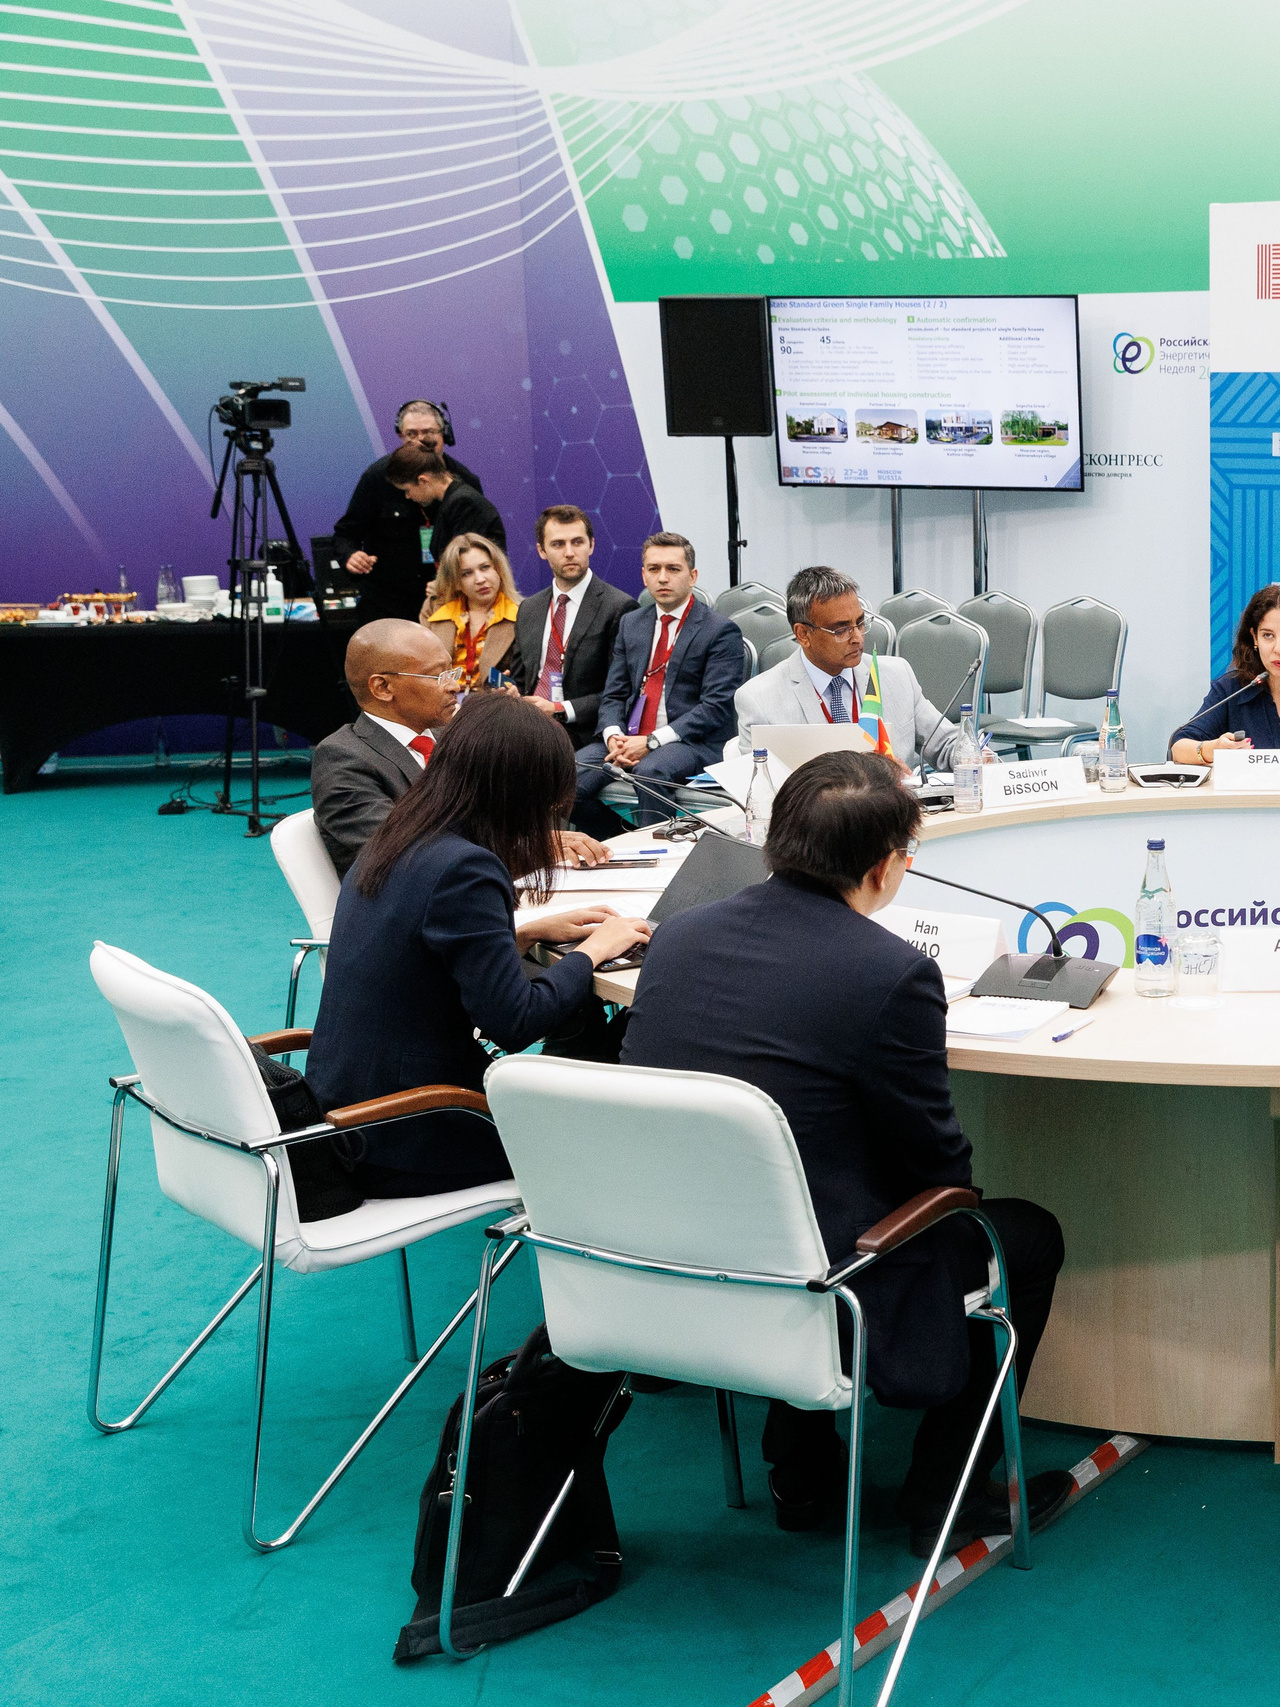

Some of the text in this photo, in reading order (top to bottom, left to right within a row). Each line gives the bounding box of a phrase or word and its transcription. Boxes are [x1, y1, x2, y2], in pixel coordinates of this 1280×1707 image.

[846, 301, 868, 309] Single
[869, 301, 894, 309] Family
[779, 336, 785, 344] 8
[819, 336, 831, 344] 45
[1159, 336, 1210, 347] Российск
[780, 346, 792, 354] 90
[1159, 364, 1196, 375] Неделя
[783, 466, 821, 478] BRICS
[1008, 768, 1047, 779] Sadhvir
[914, 919, 939, 936] Han
